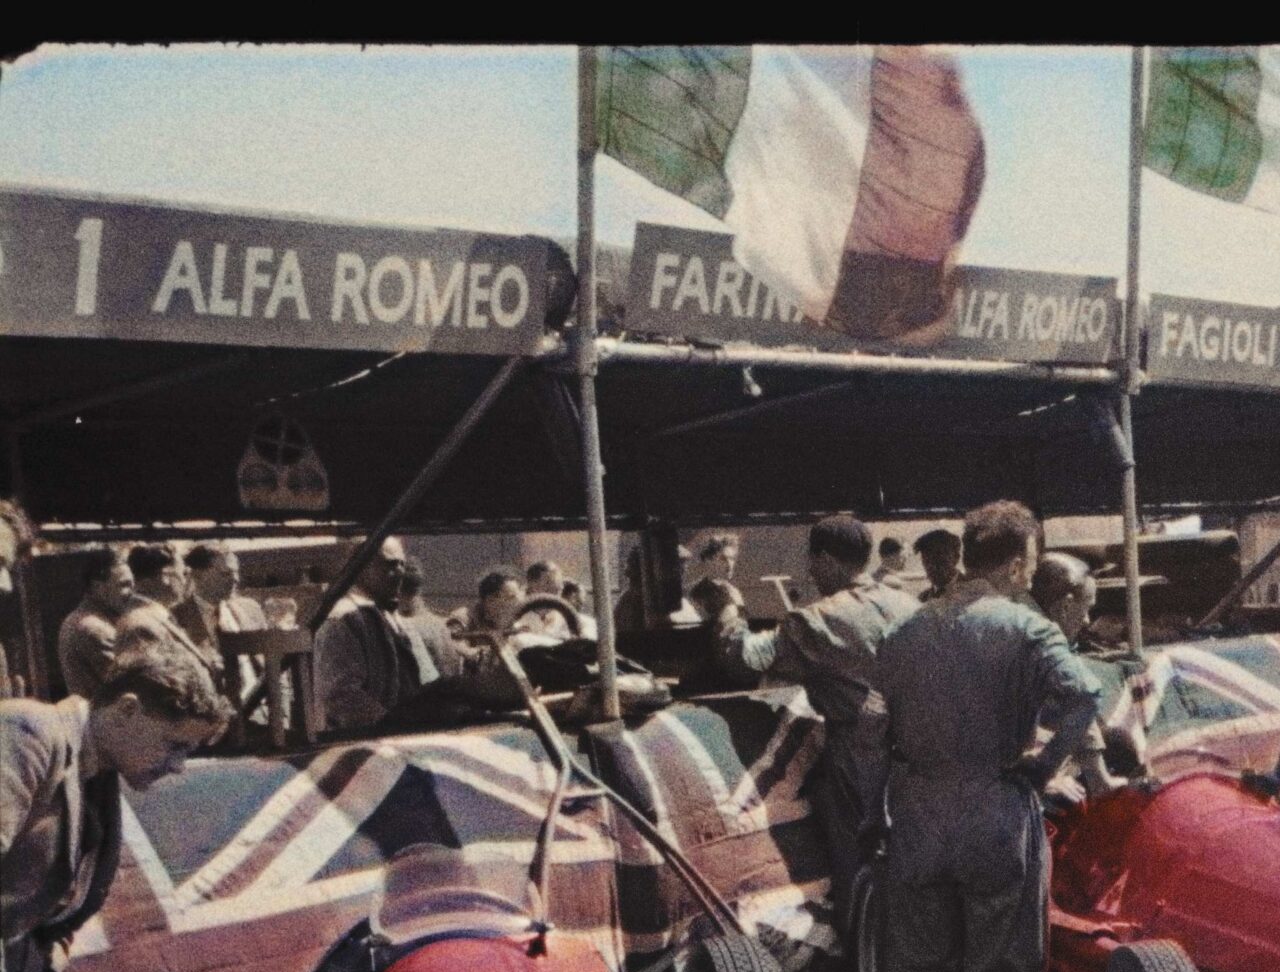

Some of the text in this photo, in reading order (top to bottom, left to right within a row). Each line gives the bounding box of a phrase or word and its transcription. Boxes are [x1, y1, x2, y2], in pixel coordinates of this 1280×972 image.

[74, 217, 103, 315] 1
[151, 239, 310, 320] ALFA
[330, 252, 530, 330] ROMEO
[649, 252, 804, 323] FARIN
[1017, 291, 1108, 343] ROMEO
[1159, 310, 1278, 367] FAGIOLI
